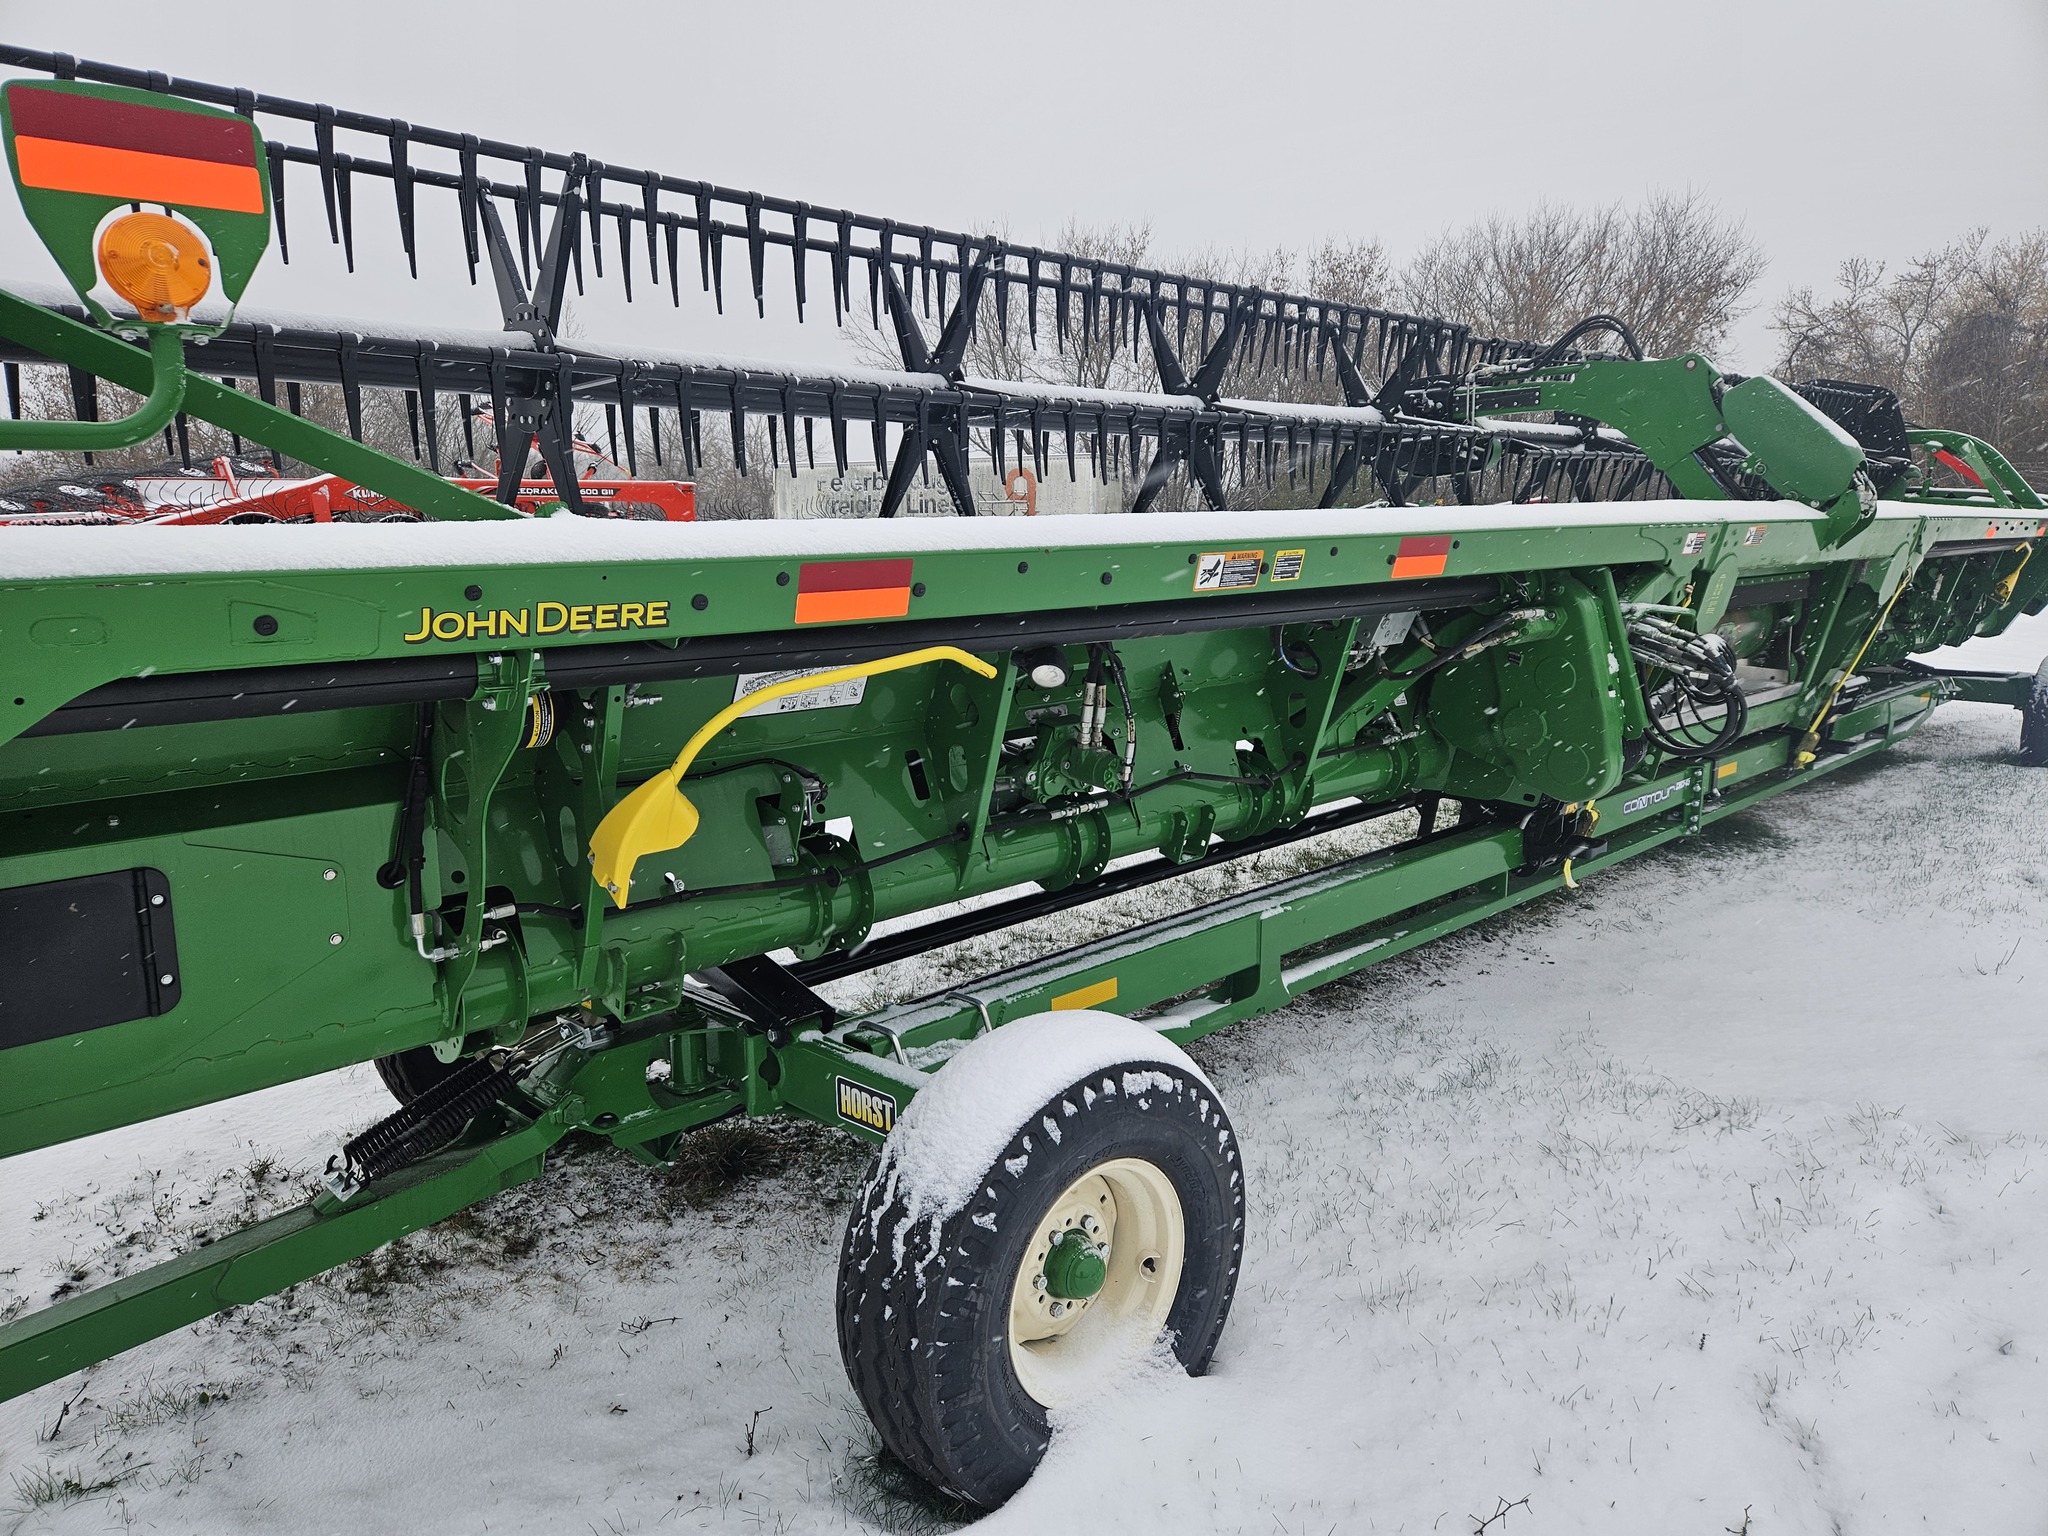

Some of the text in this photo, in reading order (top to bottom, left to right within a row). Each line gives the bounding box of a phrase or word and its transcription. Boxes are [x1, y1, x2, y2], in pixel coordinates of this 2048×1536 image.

[352, 488, 384, 498] KUH
[517, 487, 559, 495] EDRAK
[404, 600, 670, 644] JOHN DEERE
[840, 1084, 893, 1131] HORST
